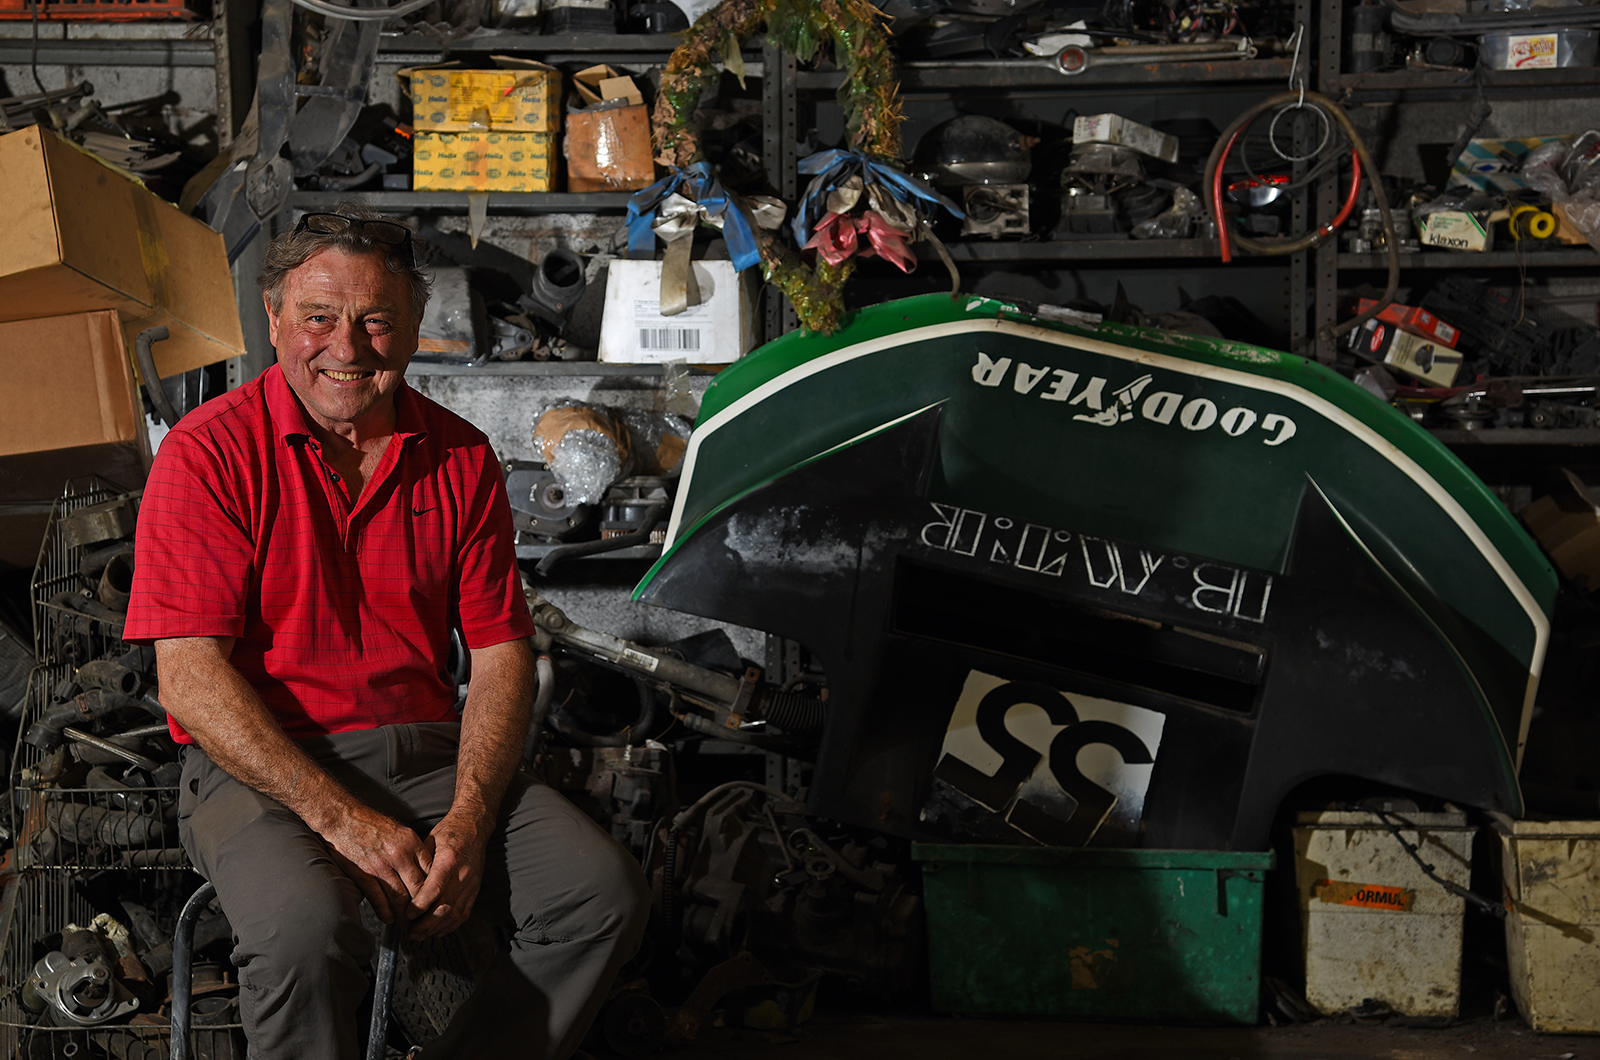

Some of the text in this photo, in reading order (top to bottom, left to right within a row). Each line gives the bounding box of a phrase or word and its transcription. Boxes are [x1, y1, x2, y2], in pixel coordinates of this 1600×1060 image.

[428, 94, 447, 102] Hella
[507, 169, 526, 177] Hella
[1429, 233, 1469, 248] klaxon
[934, 679, 1154, 847] 55
